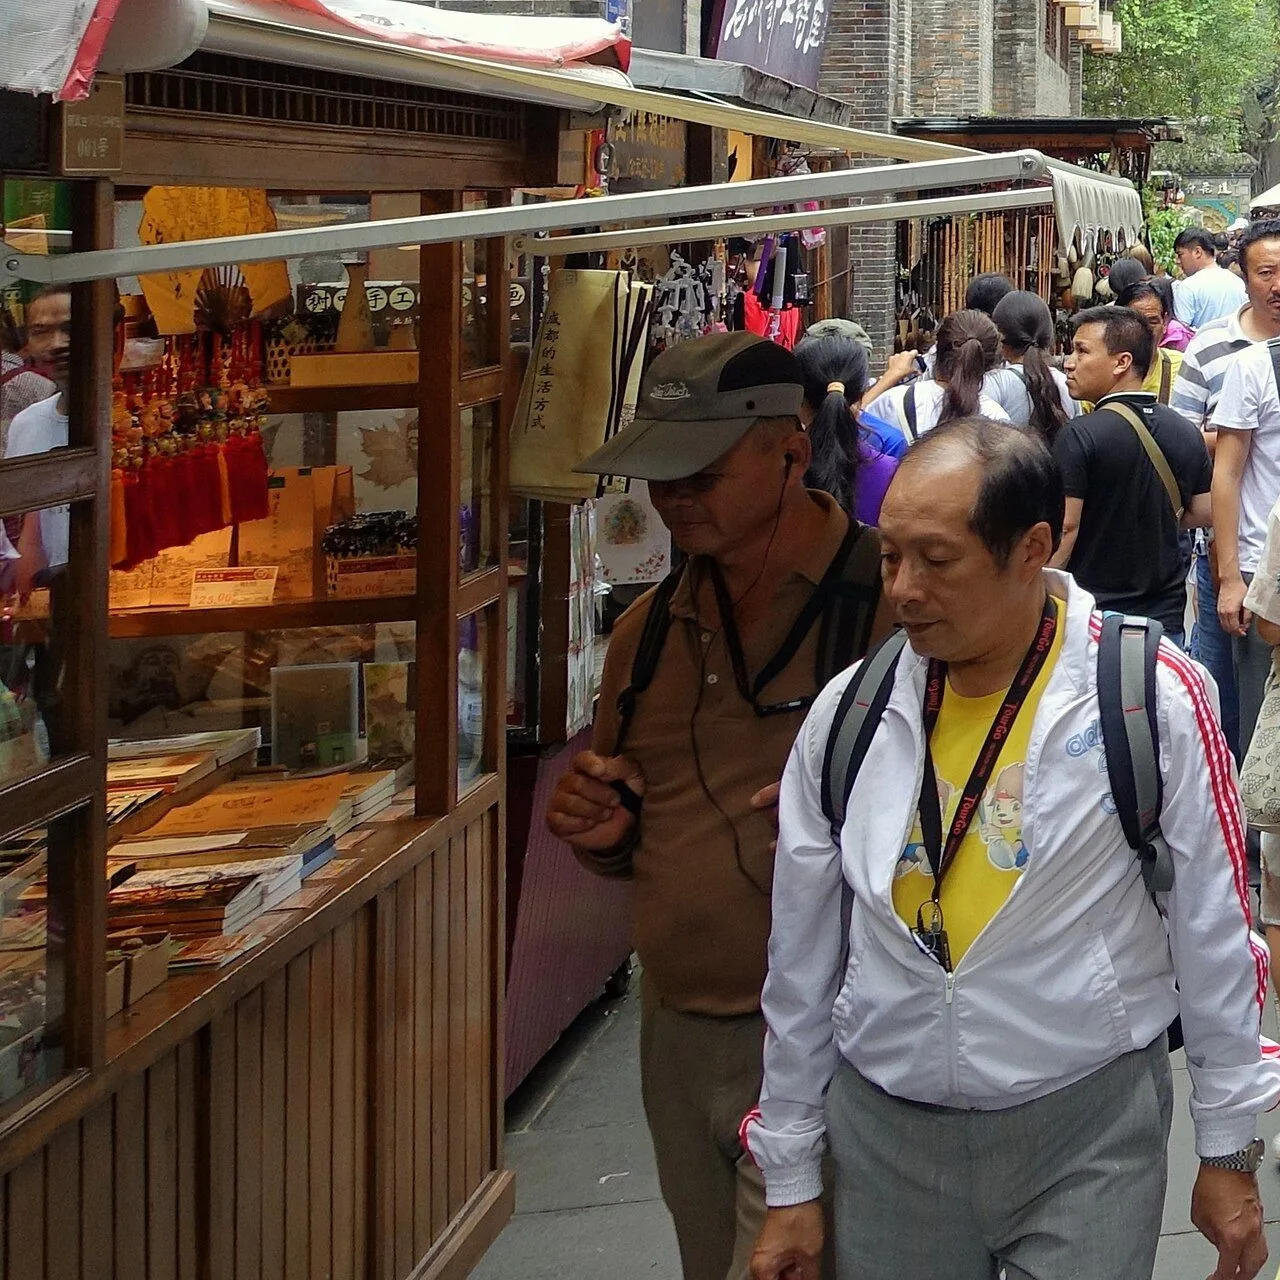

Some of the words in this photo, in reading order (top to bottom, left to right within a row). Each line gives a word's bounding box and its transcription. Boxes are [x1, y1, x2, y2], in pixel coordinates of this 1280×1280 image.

[530, 311, 561, 430] 成都的生活方式
[1036, 615, 1057, 652] TourGo
[993, 701, 1020, 740] TourGo
[950, 792, 979, 836] TourGo
